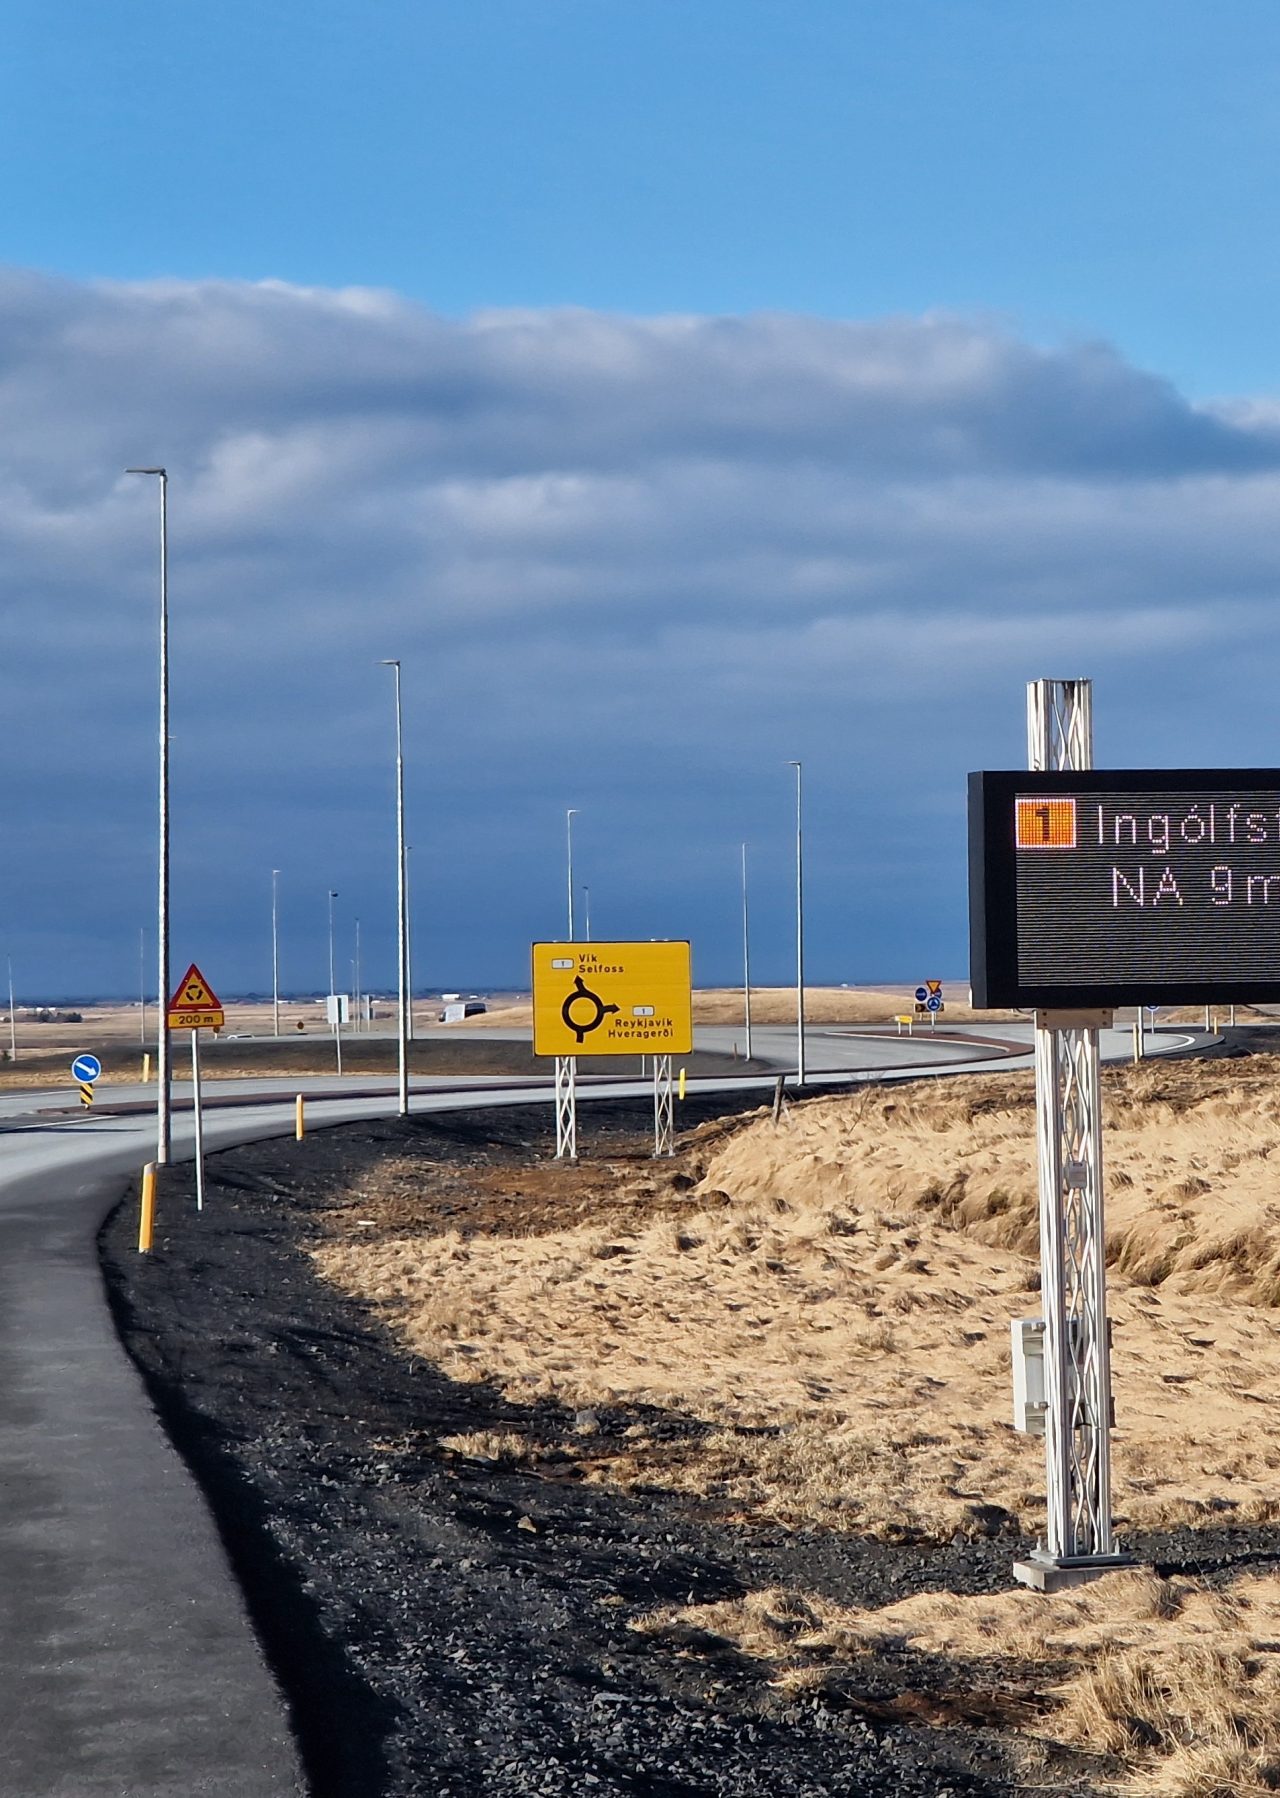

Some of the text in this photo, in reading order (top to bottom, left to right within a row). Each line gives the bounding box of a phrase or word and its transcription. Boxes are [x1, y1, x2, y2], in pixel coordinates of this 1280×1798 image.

[1036, 806, 1050, 842] 1
[1112, 866, 1183, 906] NA
[578, 964, 625, 973] Selfoss
[178, 1014, 201, 1025] 200
[608, 1028, 674, 1039] Hveragerði
